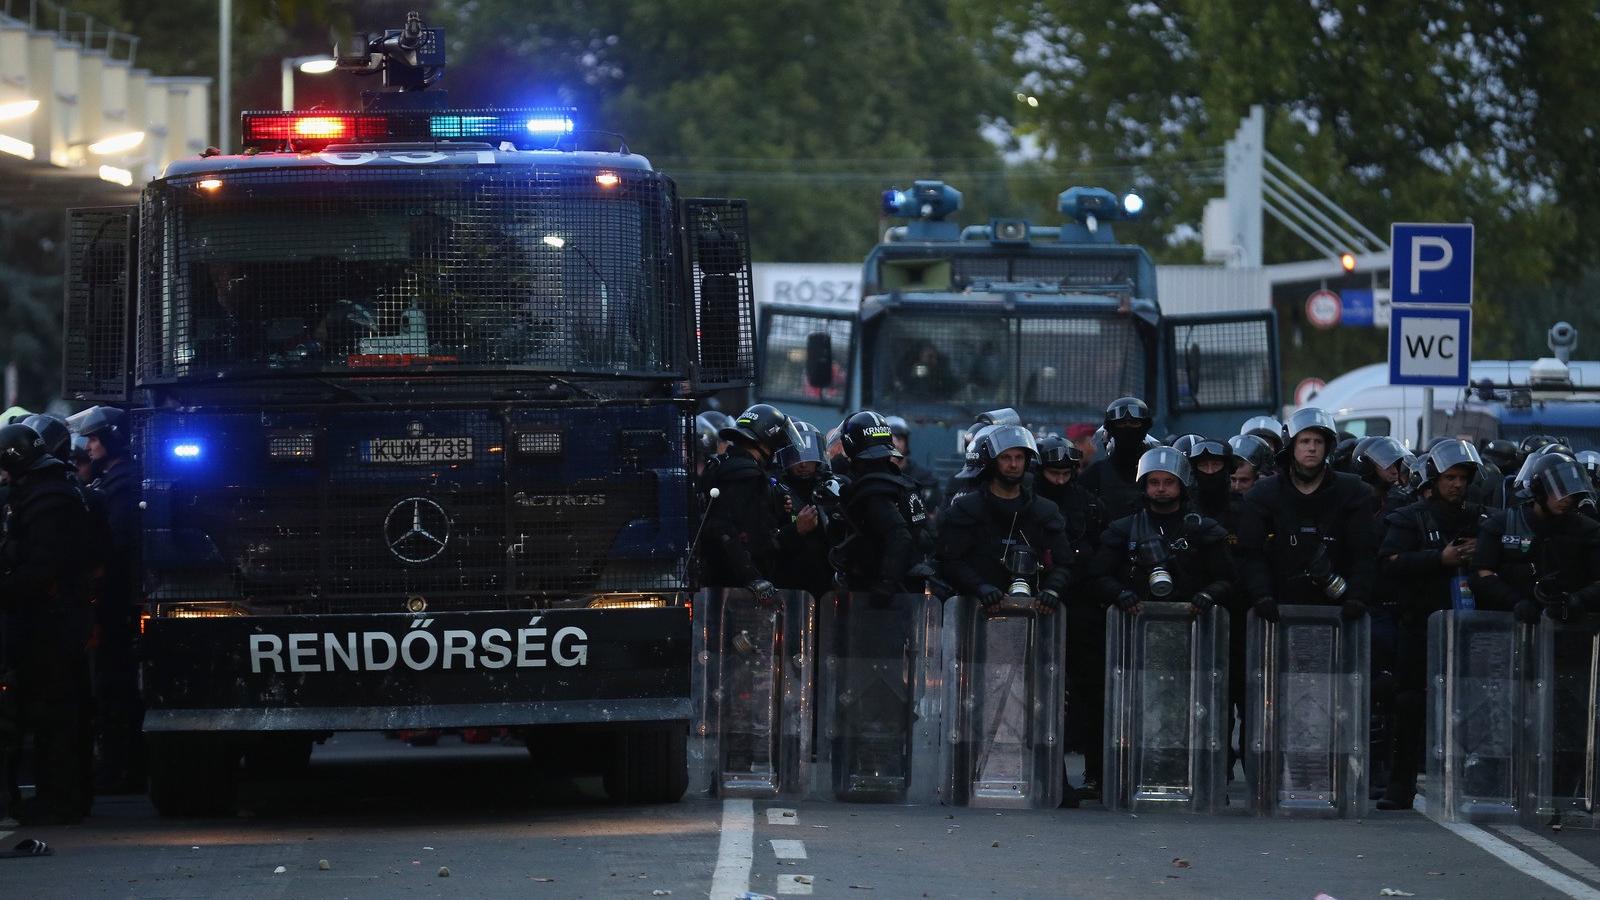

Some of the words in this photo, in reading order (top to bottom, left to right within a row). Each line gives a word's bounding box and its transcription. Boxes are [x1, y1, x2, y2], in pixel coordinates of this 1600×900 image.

[1410, 236, 1453, 295] P
[1405, 334, 1454, 359] WC
[249, 616, 589, 673] RENDŐRSÉG
